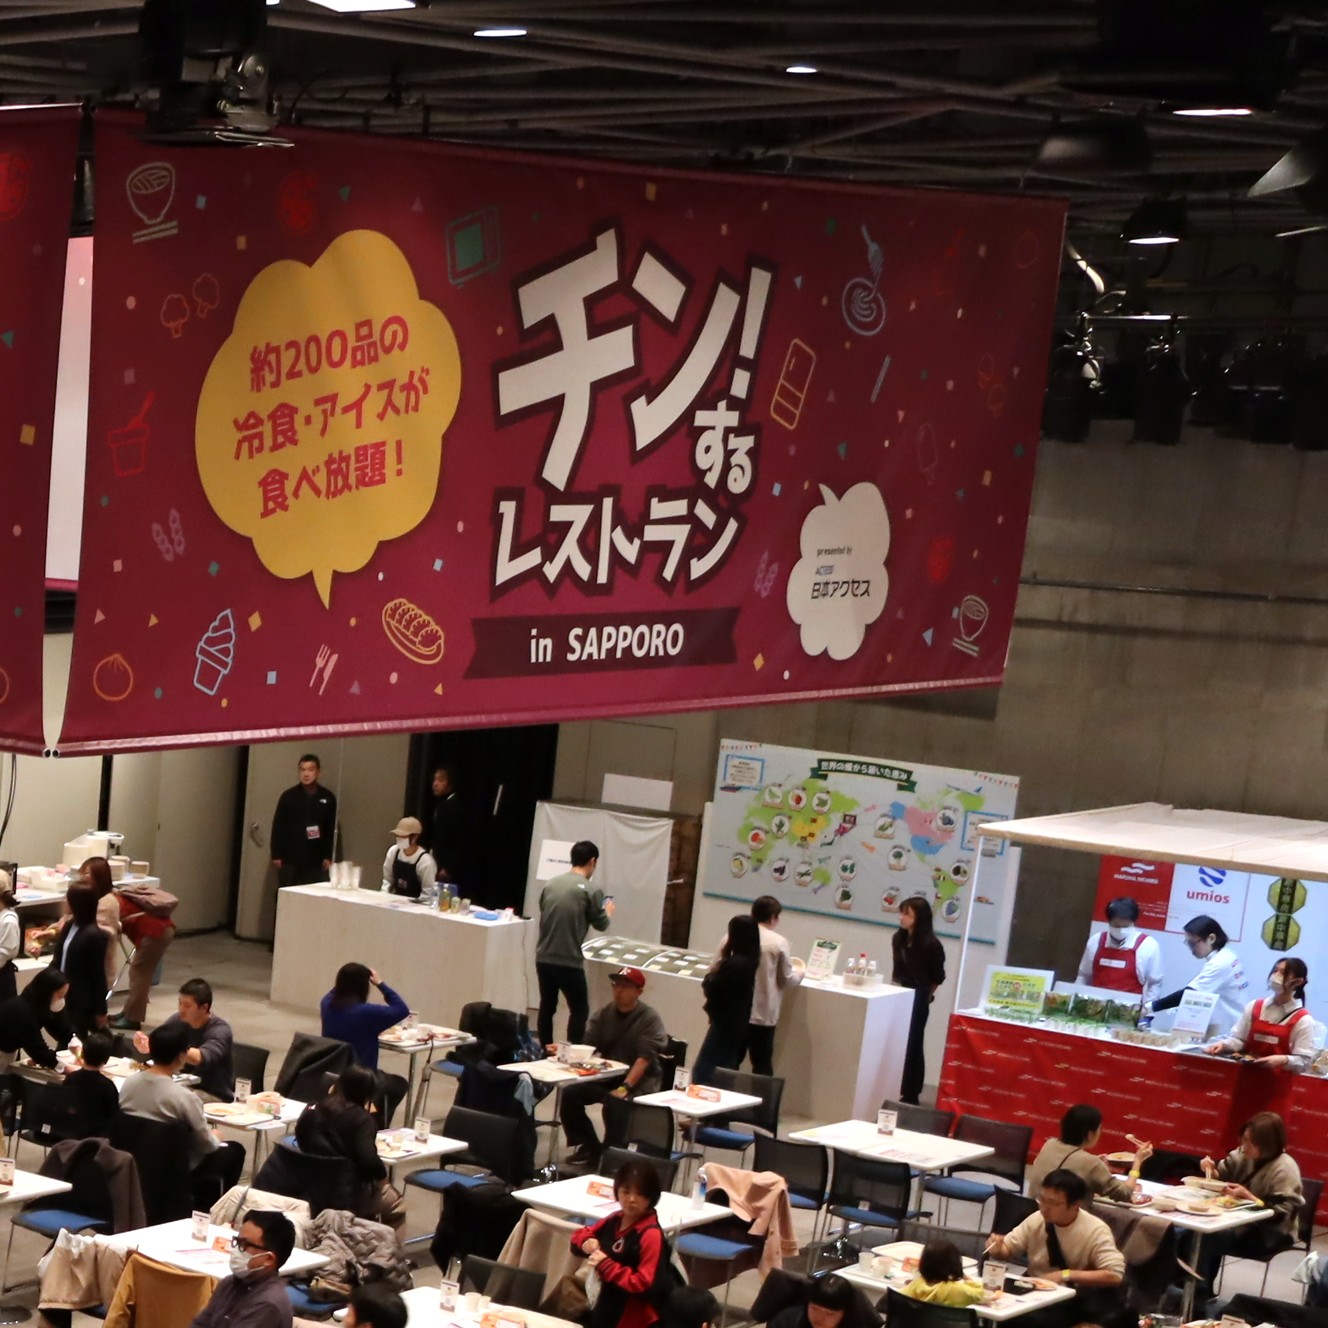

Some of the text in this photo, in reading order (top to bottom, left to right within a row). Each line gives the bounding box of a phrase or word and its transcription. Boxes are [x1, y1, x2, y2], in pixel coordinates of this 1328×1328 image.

[249, 315, 409, 393] 約200品の
[498, 227, 772, 492] チン!
[232, 366, 430, 461] 冷食・アイスが
[693, 399, 756, 494] する
[257, 439, 403, 520] 食べ放題!
[495, 497, 739, 586] レストラン
[811, 579, 871, 600] 日本アクセス
[530, 622, 685, 663] in SAPPORO
[1187, 889, 1230, 904] umios
